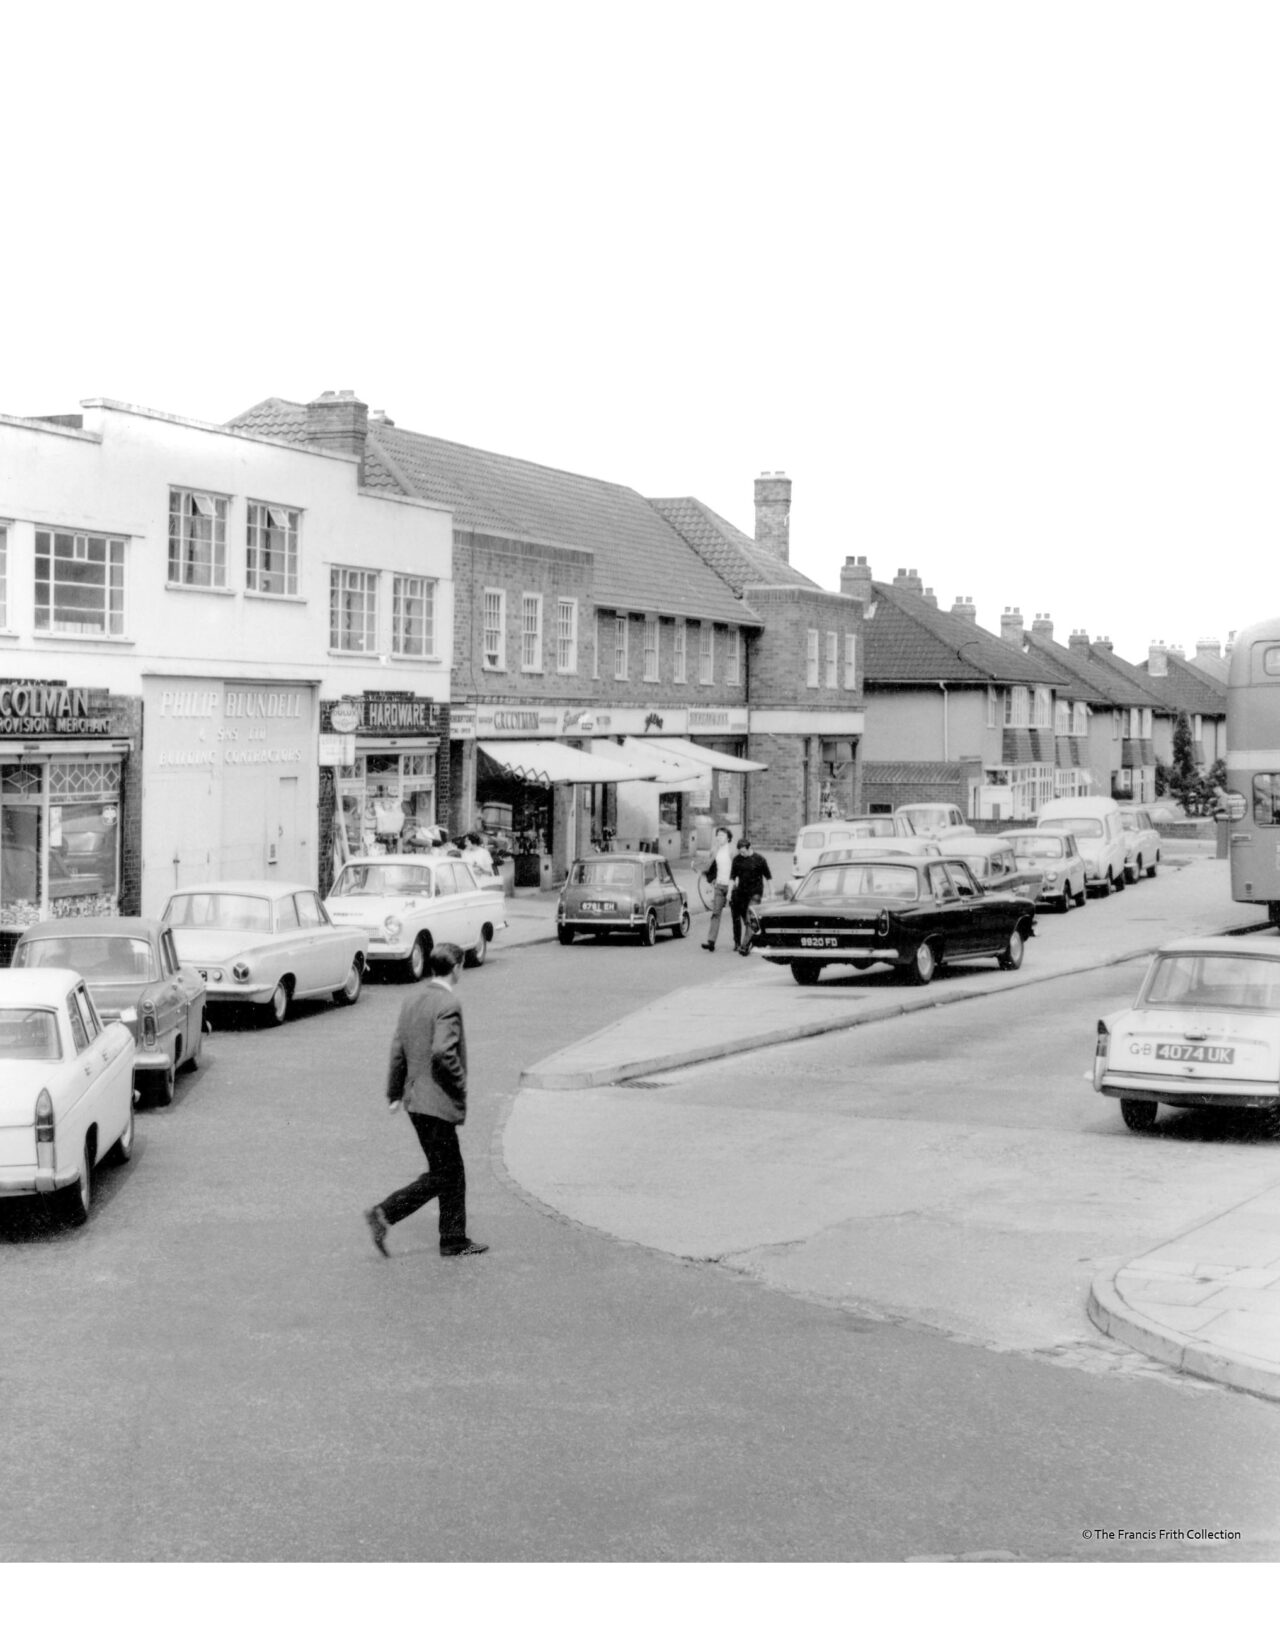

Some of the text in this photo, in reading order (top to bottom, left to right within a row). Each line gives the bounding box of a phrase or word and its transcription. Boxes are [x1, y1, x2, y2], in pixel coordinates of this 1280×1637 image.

[160, 691, 219, 719] PHILIP
[223, 691, 302, 719] BLUNDELL
[369, 703, 426, 726] HARDWARE
[55, 717, 112, 734] MERCHANT
[160, 749, 303, 767] BUILDING CONTRACTORS
[1158, 1045, 1231, 1063] 4074 UK
